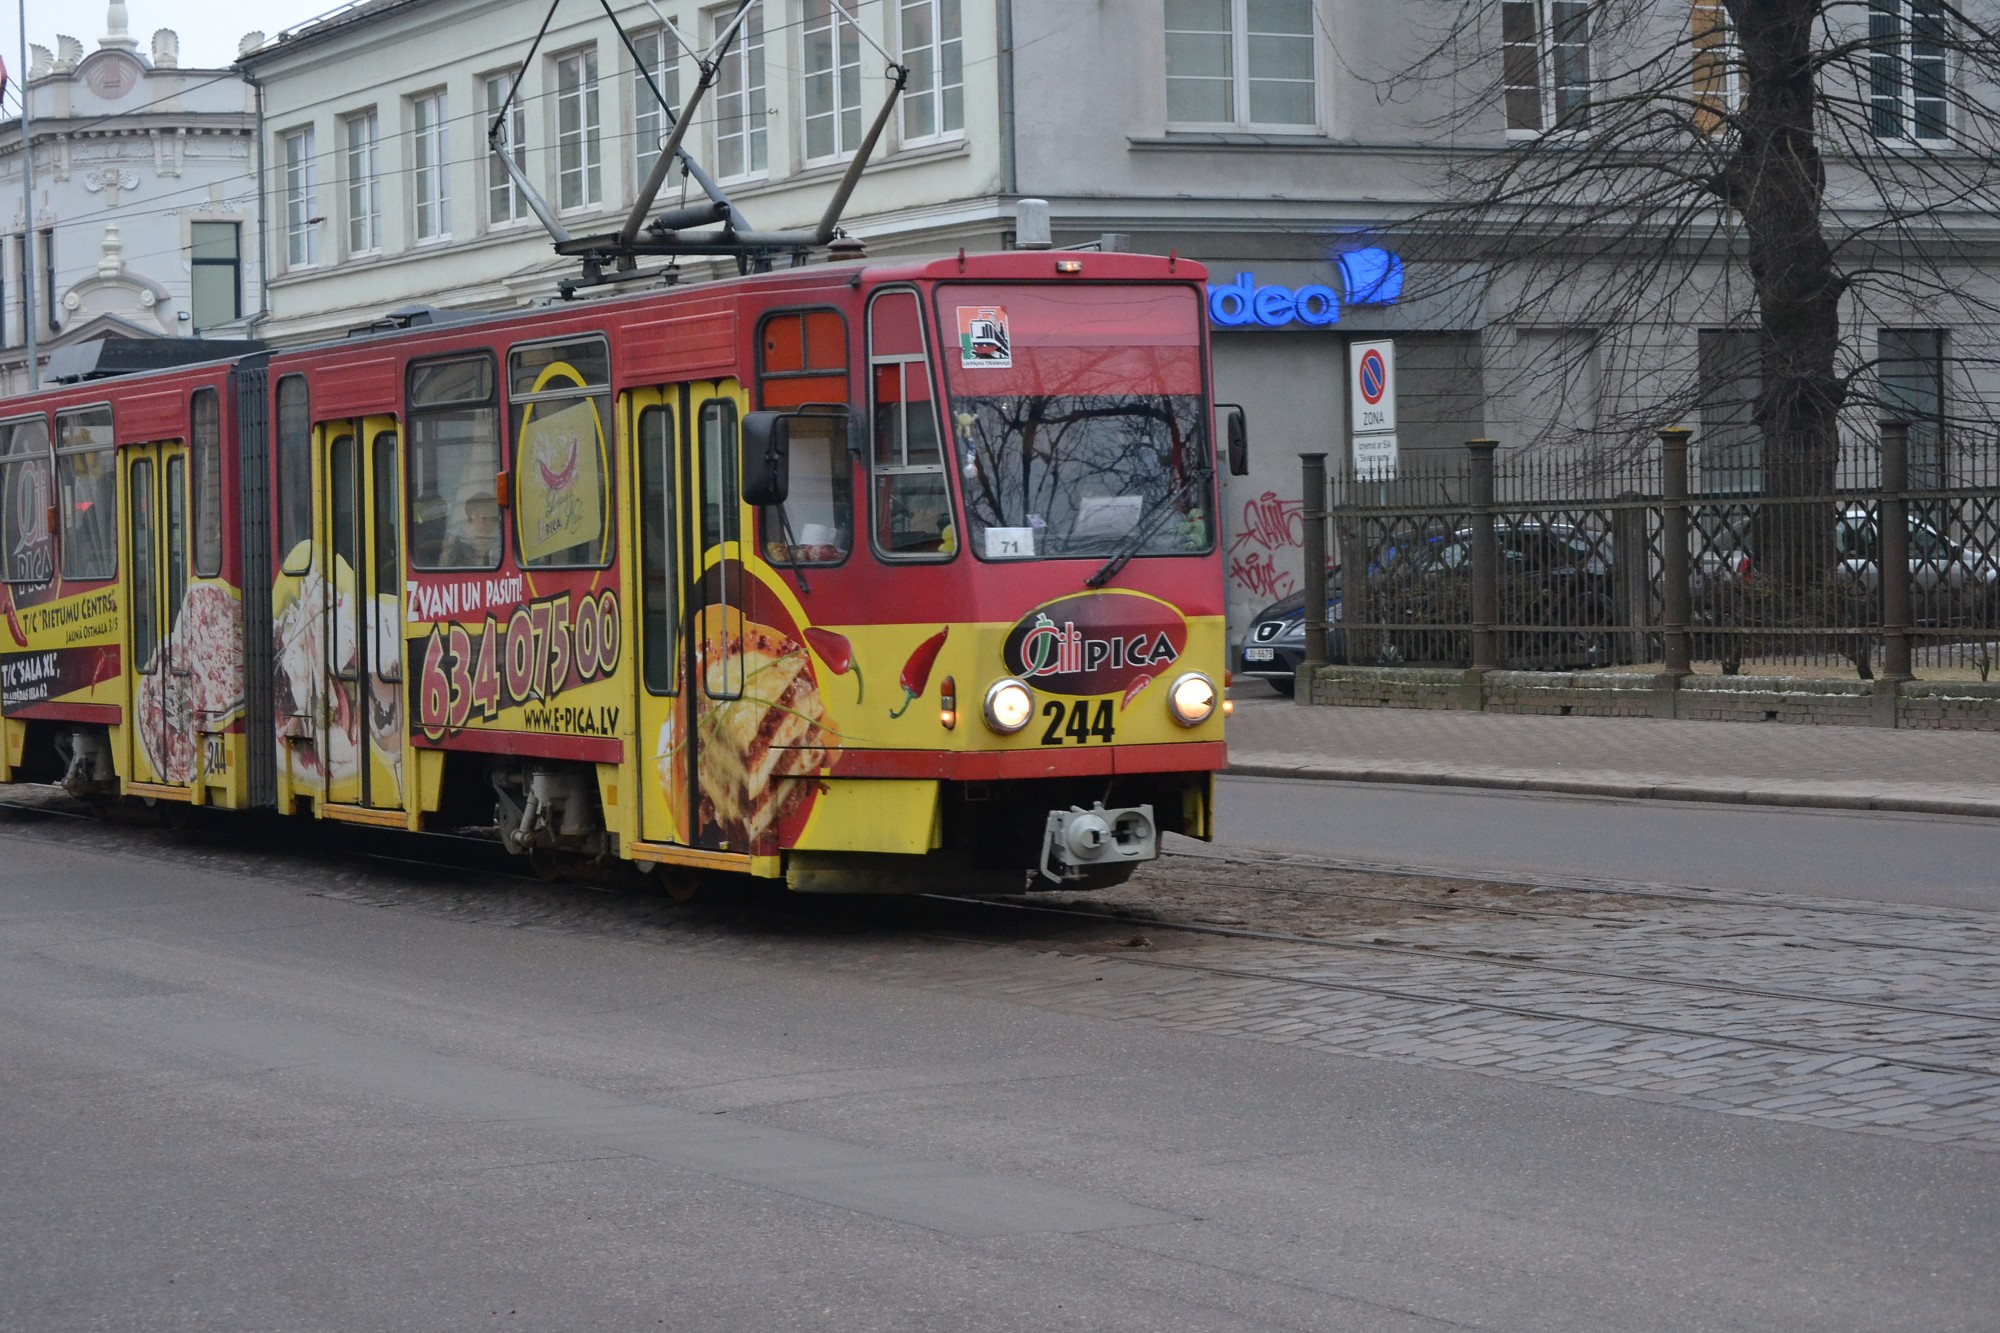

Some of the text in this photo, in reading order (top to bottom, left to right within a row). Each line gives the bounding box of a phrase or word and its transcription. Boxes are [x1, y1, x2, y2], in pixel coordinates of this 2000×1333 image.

[1206, 272, 1339, 326] dea
[1363, 411, 1385, 425] ZONA
[1001, 540, 1018, 553] 71
[406, 580, 459, 622] ZVANI
[462, 581, 480, 611] UN
[22, 612, 37, 635] T/C
[1084, 631, 1179, 672] PICA
[1, 663, 17, 688] T/C
[40, 682, 47, 698] 62
[524, 706, 619, 735] WWW.E-PICA.LV
[1041, 699, 1114, 745] 244
